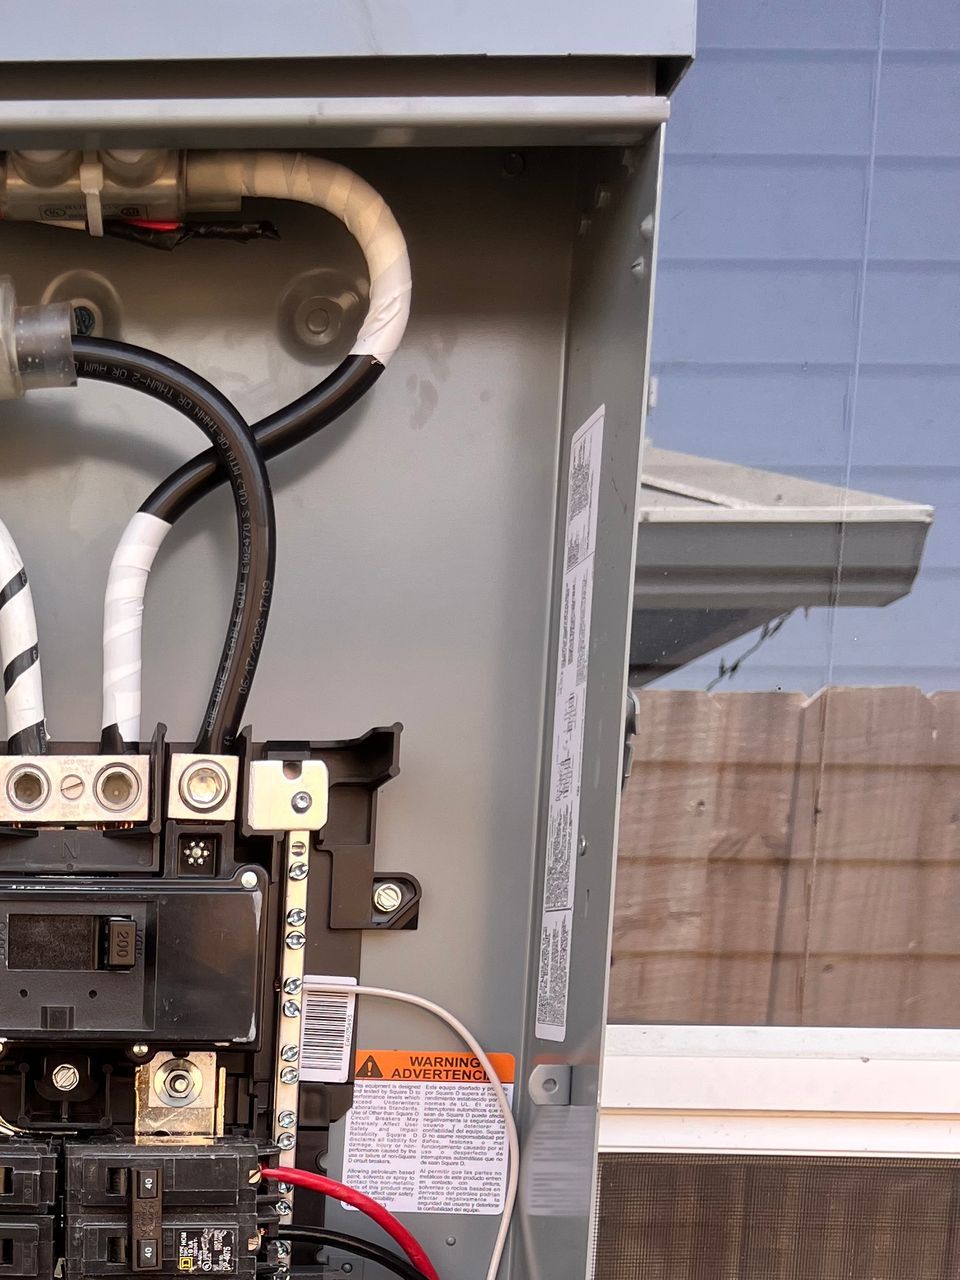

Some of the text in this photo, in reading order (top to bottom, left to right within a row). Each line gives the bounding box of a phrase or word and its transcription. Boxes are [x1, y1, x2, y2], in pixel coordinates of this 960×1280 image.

[116, 931, 129, 958] 200
[410, 1056, 481, 1068] WARNING
[144, 1178, 153, 1190] 40
[144, 1247, 152, 1258] 40
